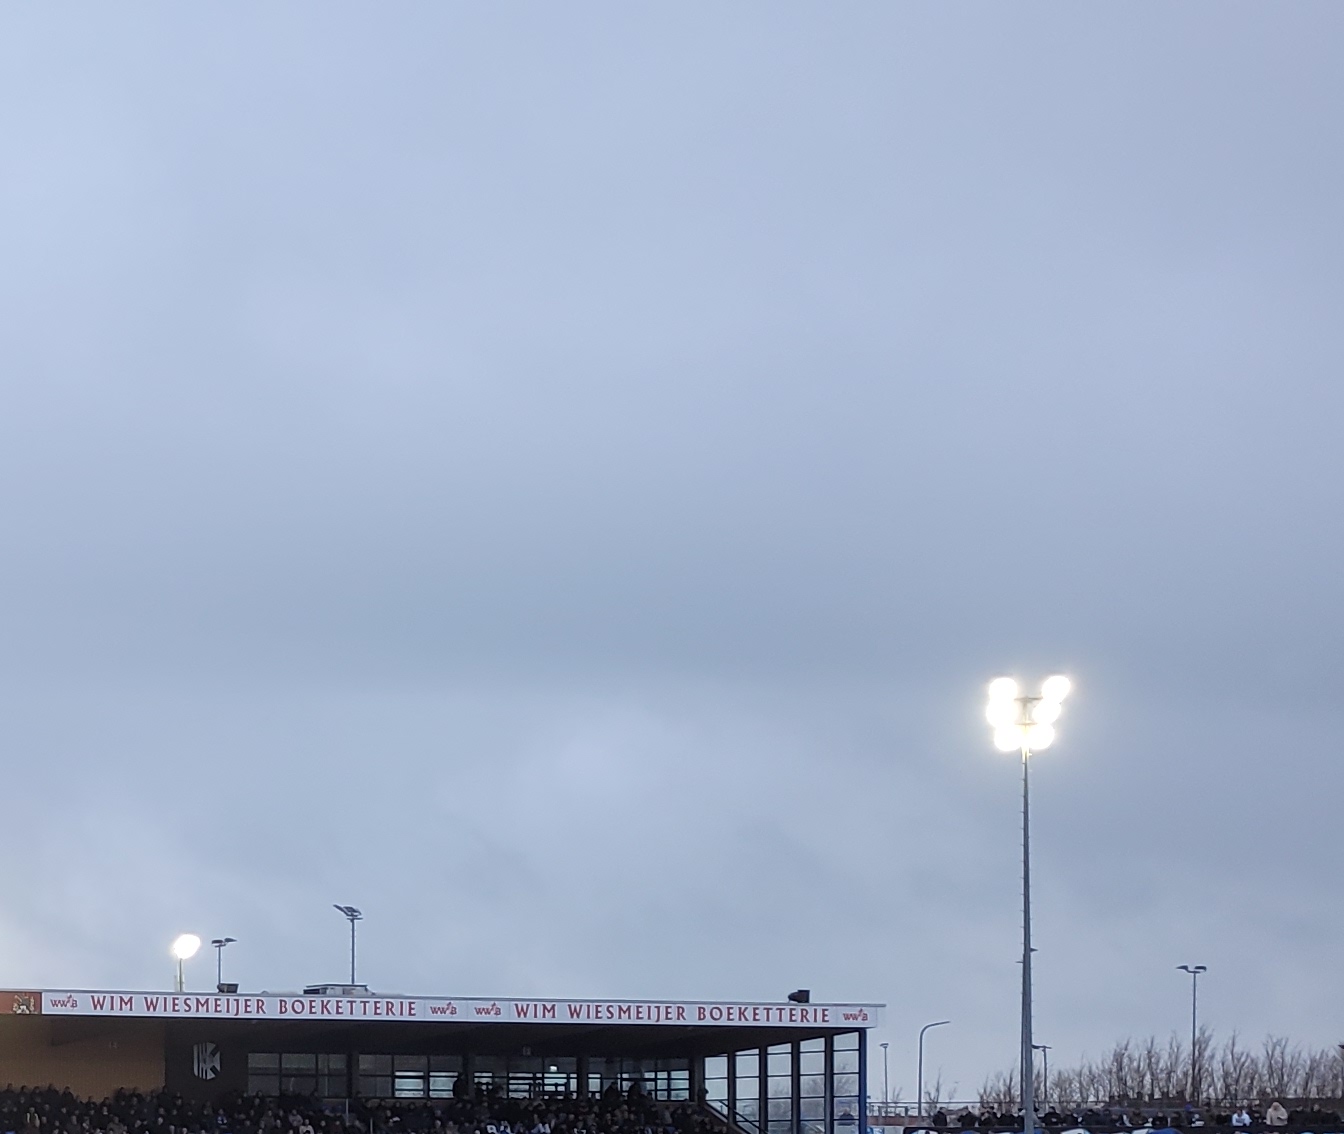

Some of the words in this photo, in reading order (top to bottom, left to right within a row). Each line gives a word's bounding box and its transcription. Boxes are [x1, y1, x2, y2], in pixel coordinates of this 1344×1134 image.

[90, 995, 134, 1012] WIM
[143, 996, 267, 1016] WIESMEIJER
[278, 999, 417, 1017] BOEKETTERIE
[514, 1003, 557, 1020] WIM
[568, 1004, 687, 1023] WIESMEIJER
[697, 1006, 831, 1024] BOEKETTERIE
